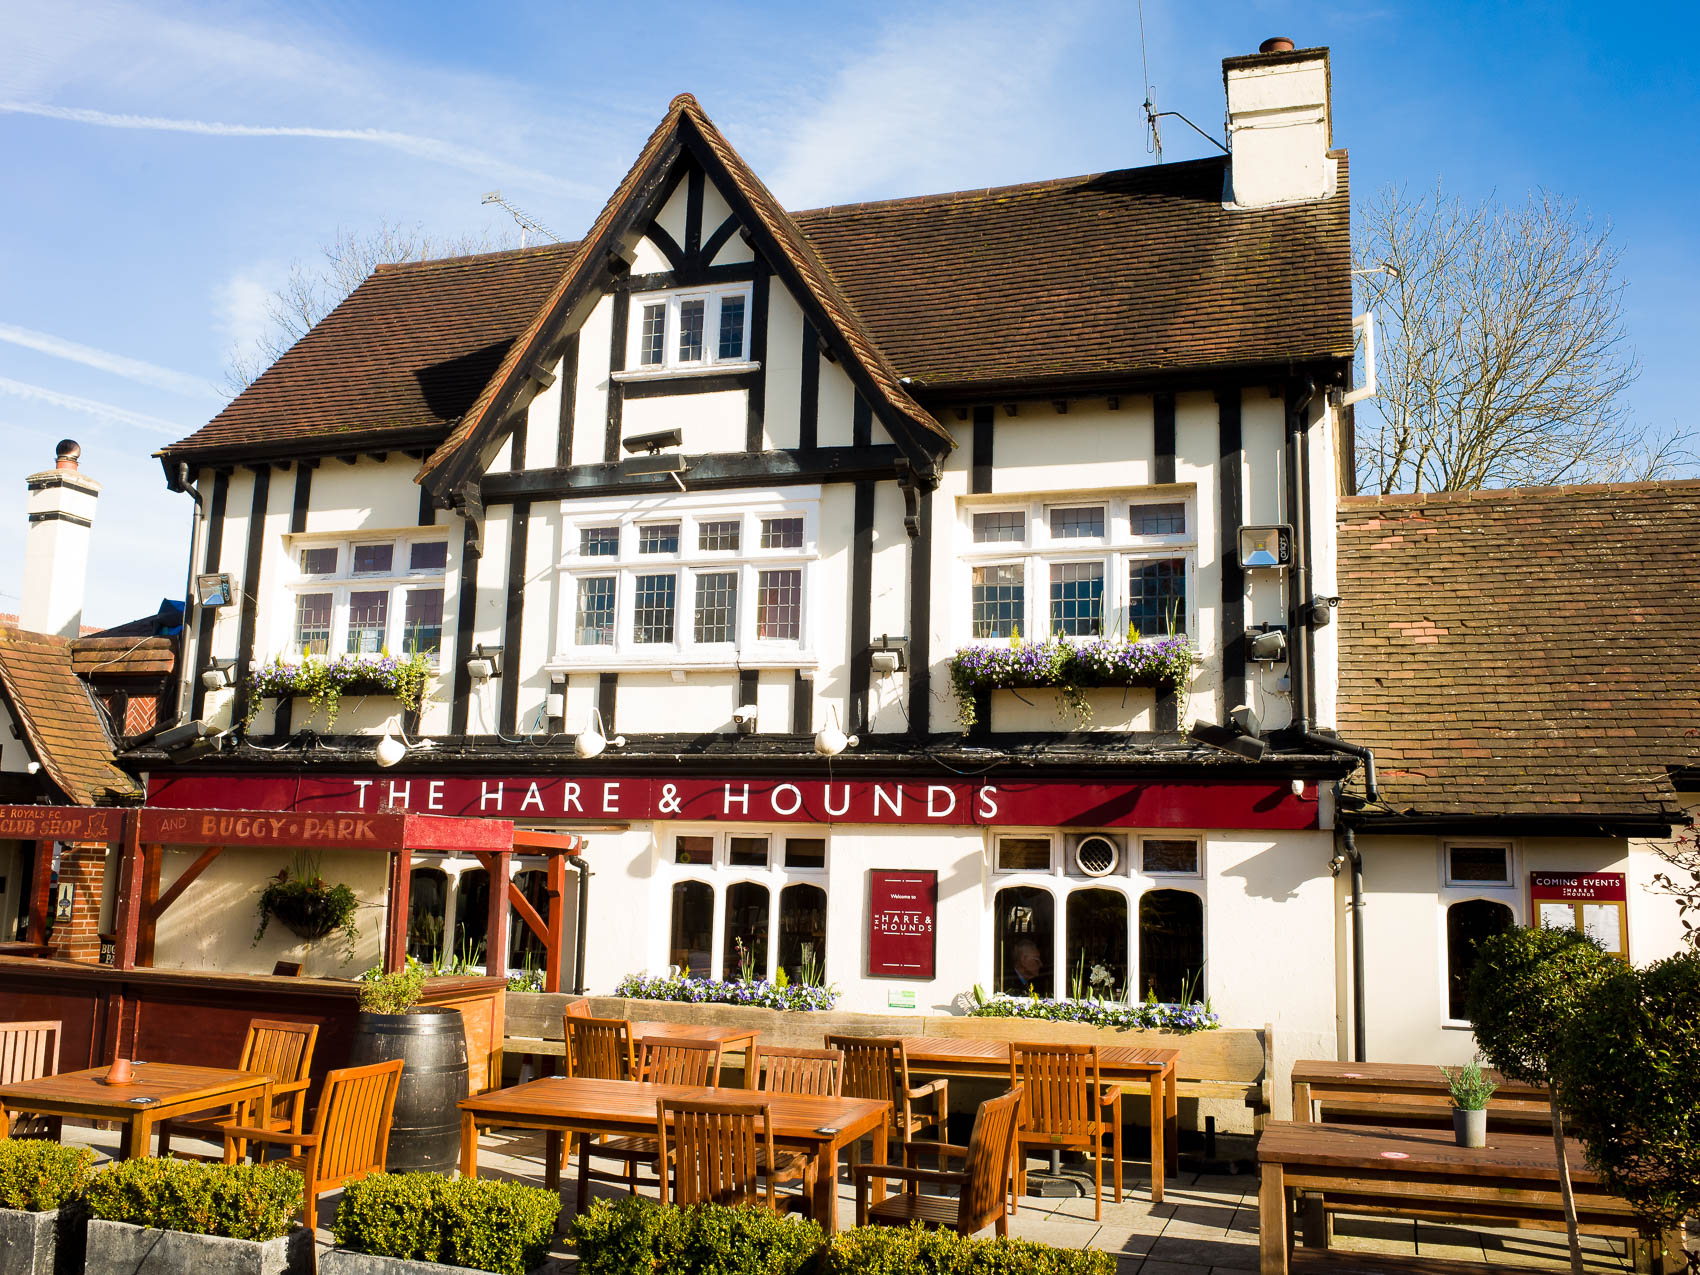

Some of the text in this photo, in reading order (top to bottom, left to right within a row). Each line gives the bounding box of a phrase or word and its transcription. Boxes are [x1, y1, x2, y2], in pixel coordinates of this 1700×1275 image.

[353, 780, 998, 819] THE HARE & HOUNDS
[10, 808, 45, 819] ROYALS
[48, 810, 61, 819] FC
[0, 819, 82, 836] CLUB SHOP
[160, 815, 376, 840] AND BUGGY PARK
[1536, 878, 1620, 887] COMING EVENTS
[881, 914, 932, 924] HARE &
[881, 923, 932, 932] HOUNDS
